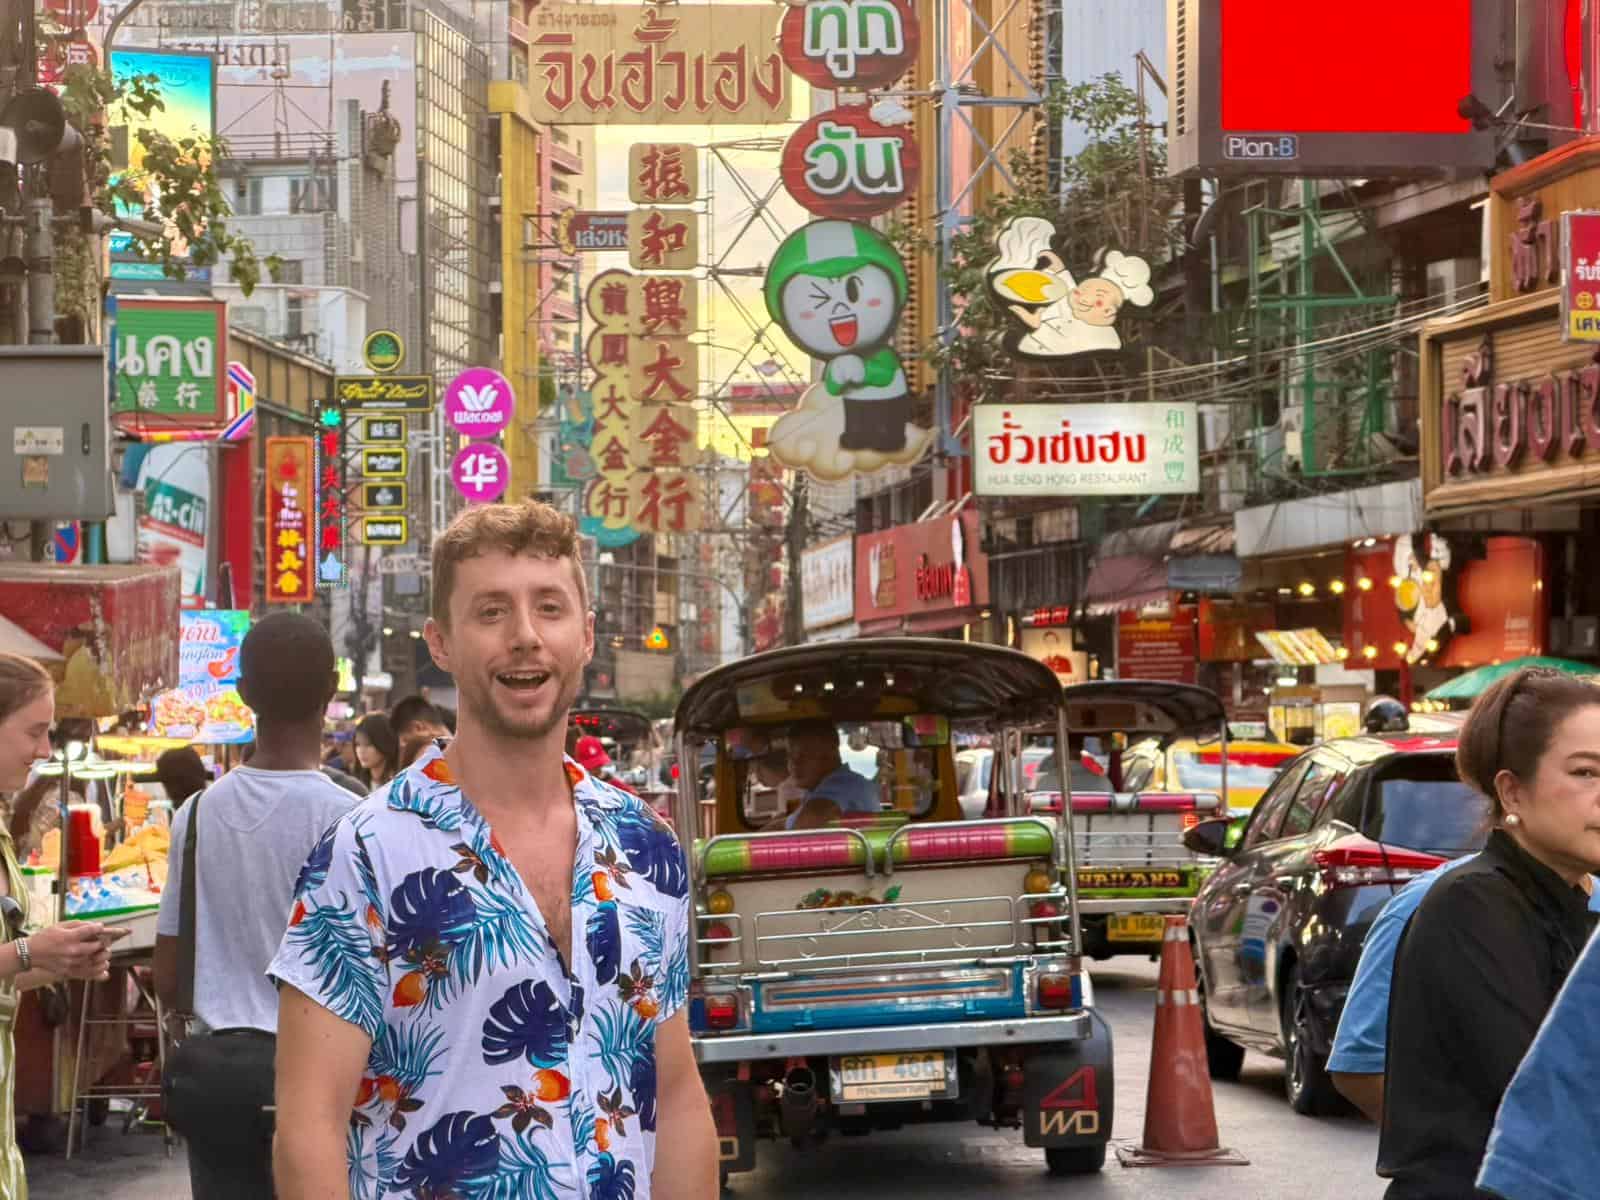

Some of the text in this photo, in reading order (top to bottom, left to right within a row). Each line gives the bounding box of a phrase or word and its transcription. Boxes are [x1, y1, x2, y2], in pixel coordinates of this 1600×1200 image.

[803, 0, 904, 78] ทุก
[803, 121, 903, 195] วัน
[1041, 1065, 1099, 1110] 4
[1040, 1110, 1099, 1135] WD
